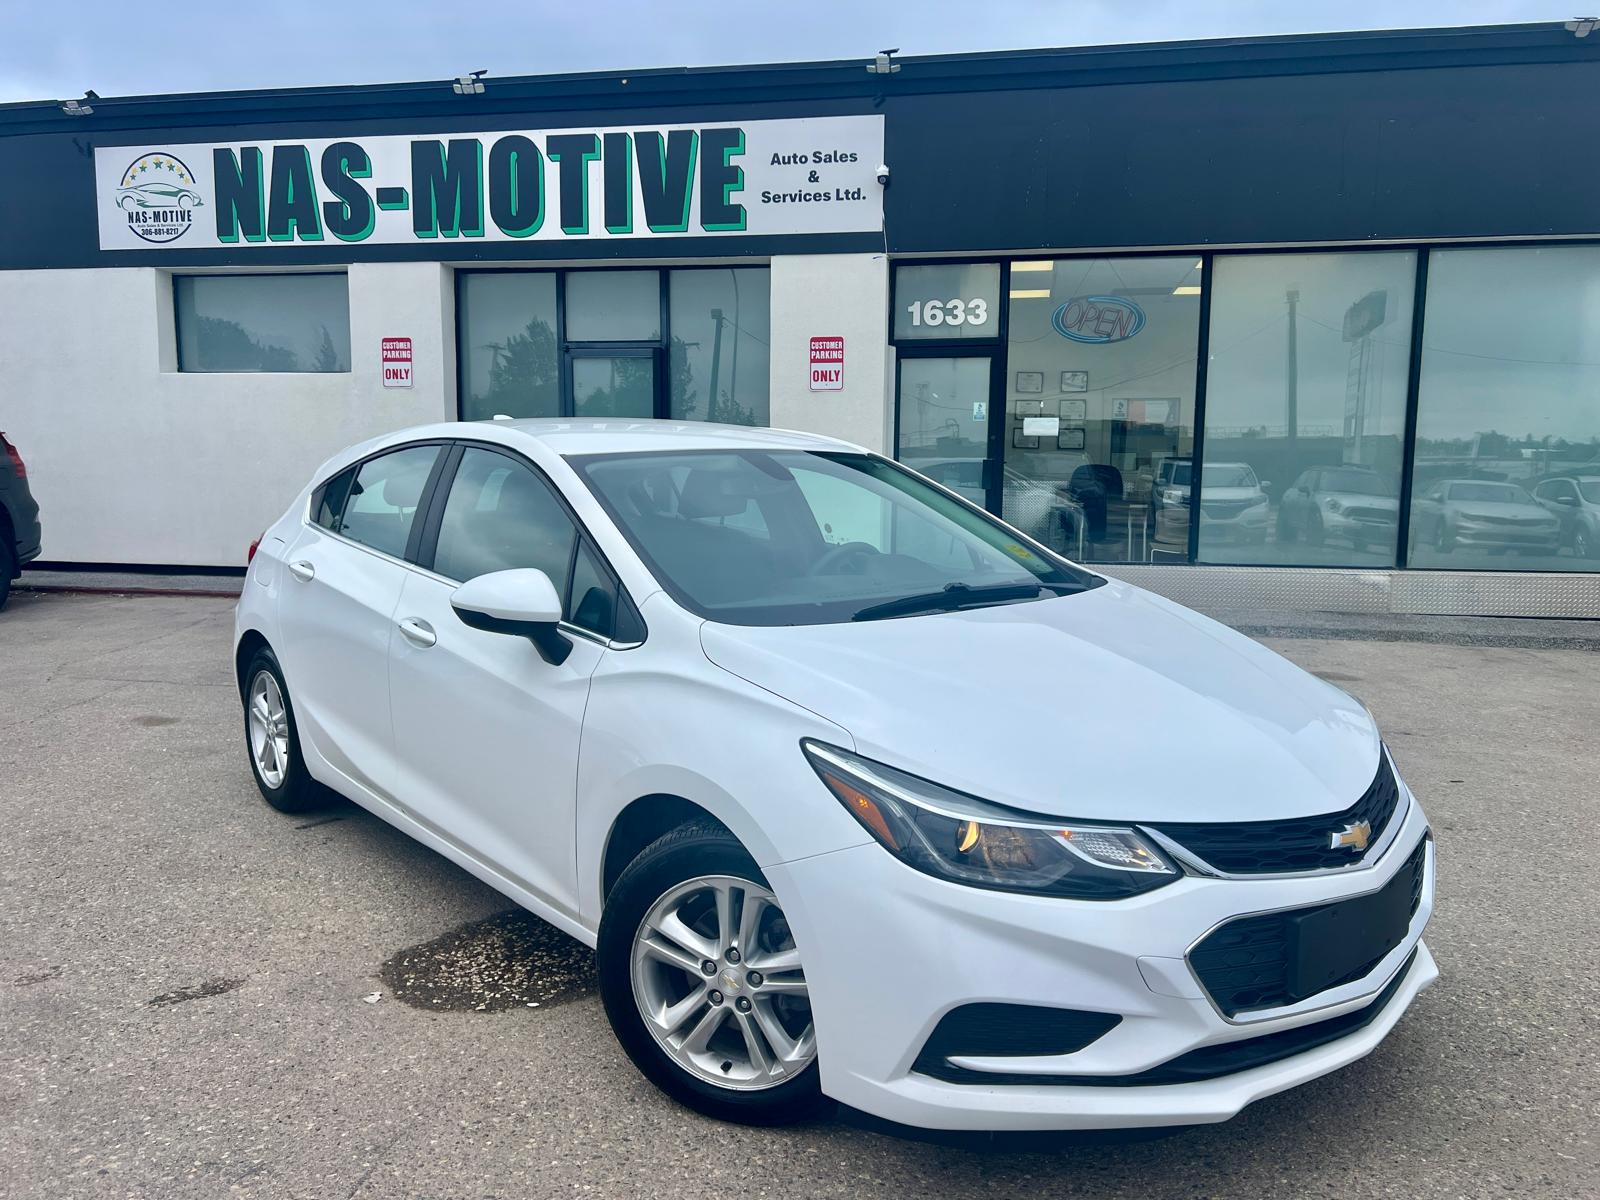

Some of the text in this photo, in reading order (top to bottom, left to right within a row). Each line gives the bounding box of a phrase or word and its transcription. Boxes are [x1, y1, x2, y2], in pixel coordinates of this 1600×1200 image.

[770, 150, 858, 166] Auto Sales
[808, 170, 820, 183] &
[213, 127, 747, 243] NAS-MOTIVE
[761, 187, 867, 204] Services Ltd.
[128, 210, 192, 223] NAS-MOTIVE
[907, 299, 988, 327] 1633
[1063, 301, 1134, 337] OPEN
[382, 341, 411, 349] CUSTOMER
[811, 341, 842, 349] CUSTOMER
[383, 350, 411, 359] PARKING
[811, 350, 842, 359] PARKING
[385, 368, 410, 380] ONLY
[812, 370, 840, 382] ONLY
